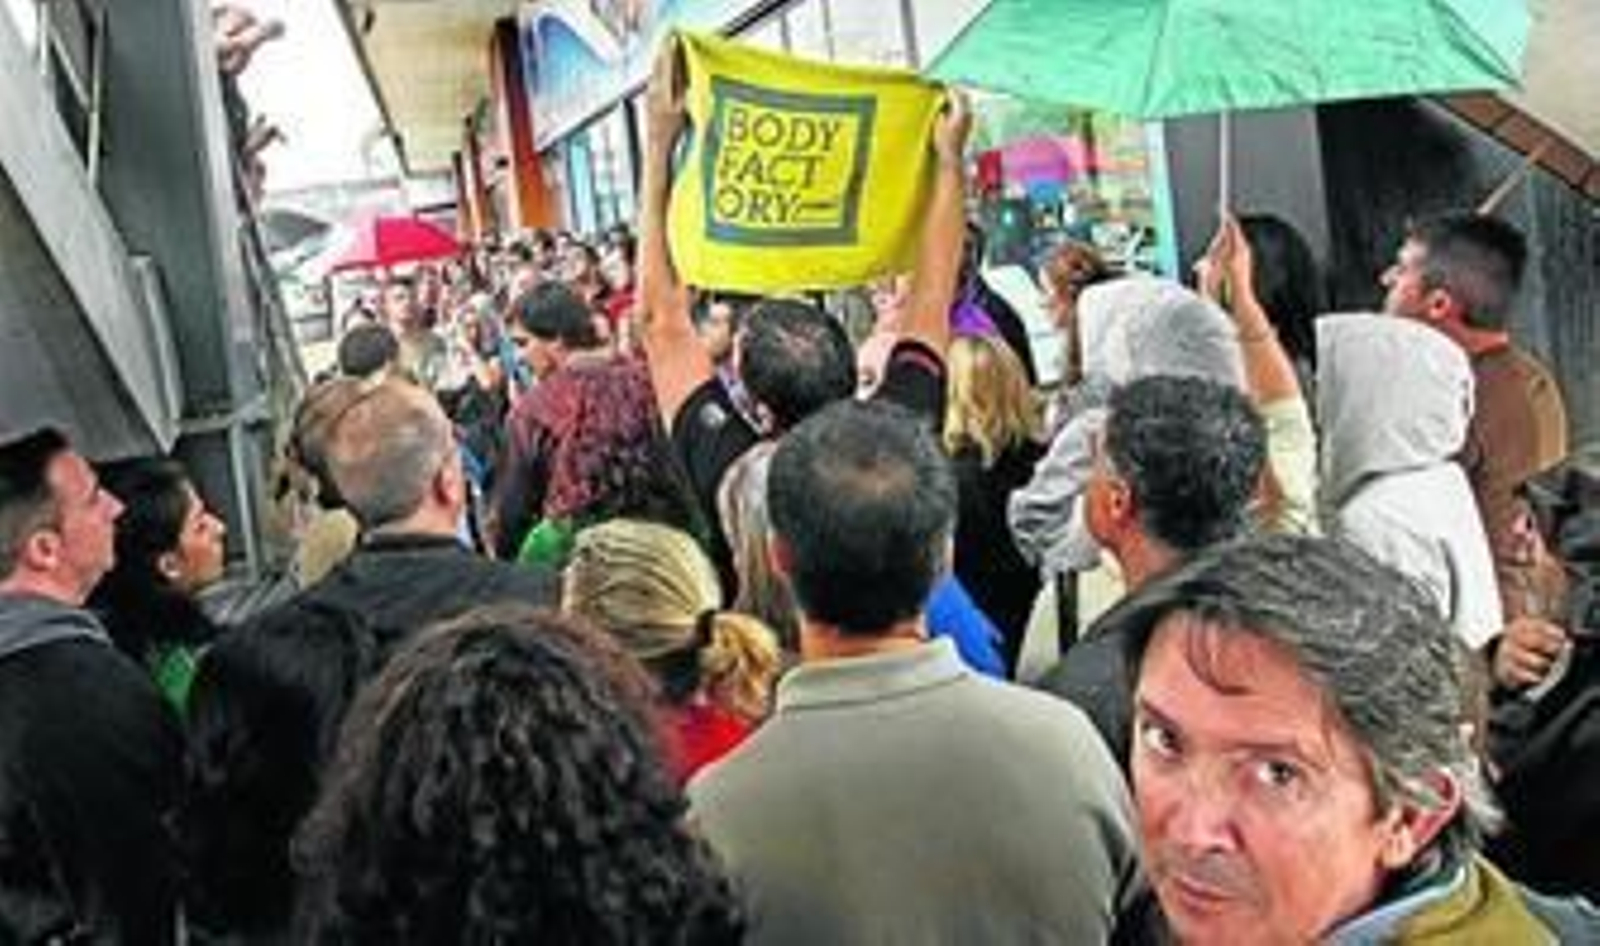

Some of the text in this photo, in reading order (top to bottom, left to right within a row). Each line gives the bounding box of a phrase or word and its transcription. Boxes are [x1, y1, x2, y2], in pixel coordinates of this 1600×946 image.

[729, 109, 841, 151] BODY
[719, 147, 826, 189] FACT
[717, 185, 801, 223] ORY
